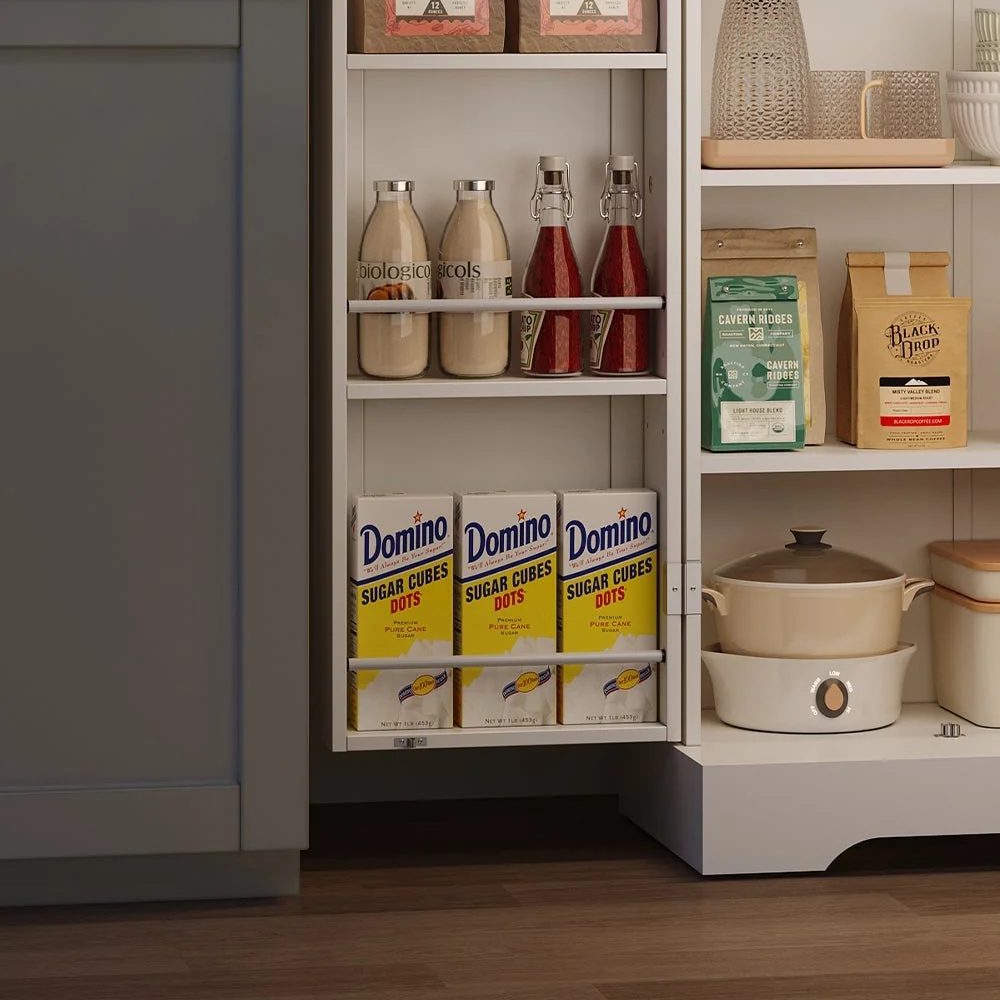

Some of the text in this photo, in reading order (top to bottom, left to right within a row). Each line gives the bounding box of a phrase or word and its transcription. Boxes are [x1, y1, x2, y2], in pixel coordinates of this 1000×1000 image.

[431, 1, 440, 10] 12
[585, 1, 593, 10] 12
[718, 314, 793, 325] CAVERN RIDGES
[884, 323, 939, 347] BLACK
[901, 337, 940, 359] DROP
[766, 360, 799, 370] CAVERN
[766, 370, 800, 381] RIDGES
[360, 511, 448, 566] Domino
[464, 509, 551, 563] Domino
[565, 507, 652, 561] Domino
[361, 562, 449, 605] SUGAR CUBES
[465, 559, 552, 603] SUGAR CUBES
[567, 557, 653, 600] SUGAR CUBES
[390, 590, 421, 614] DOTS
[494, 588, 524, 612] DOTS
[595, 585, 625, 609] DOTS
